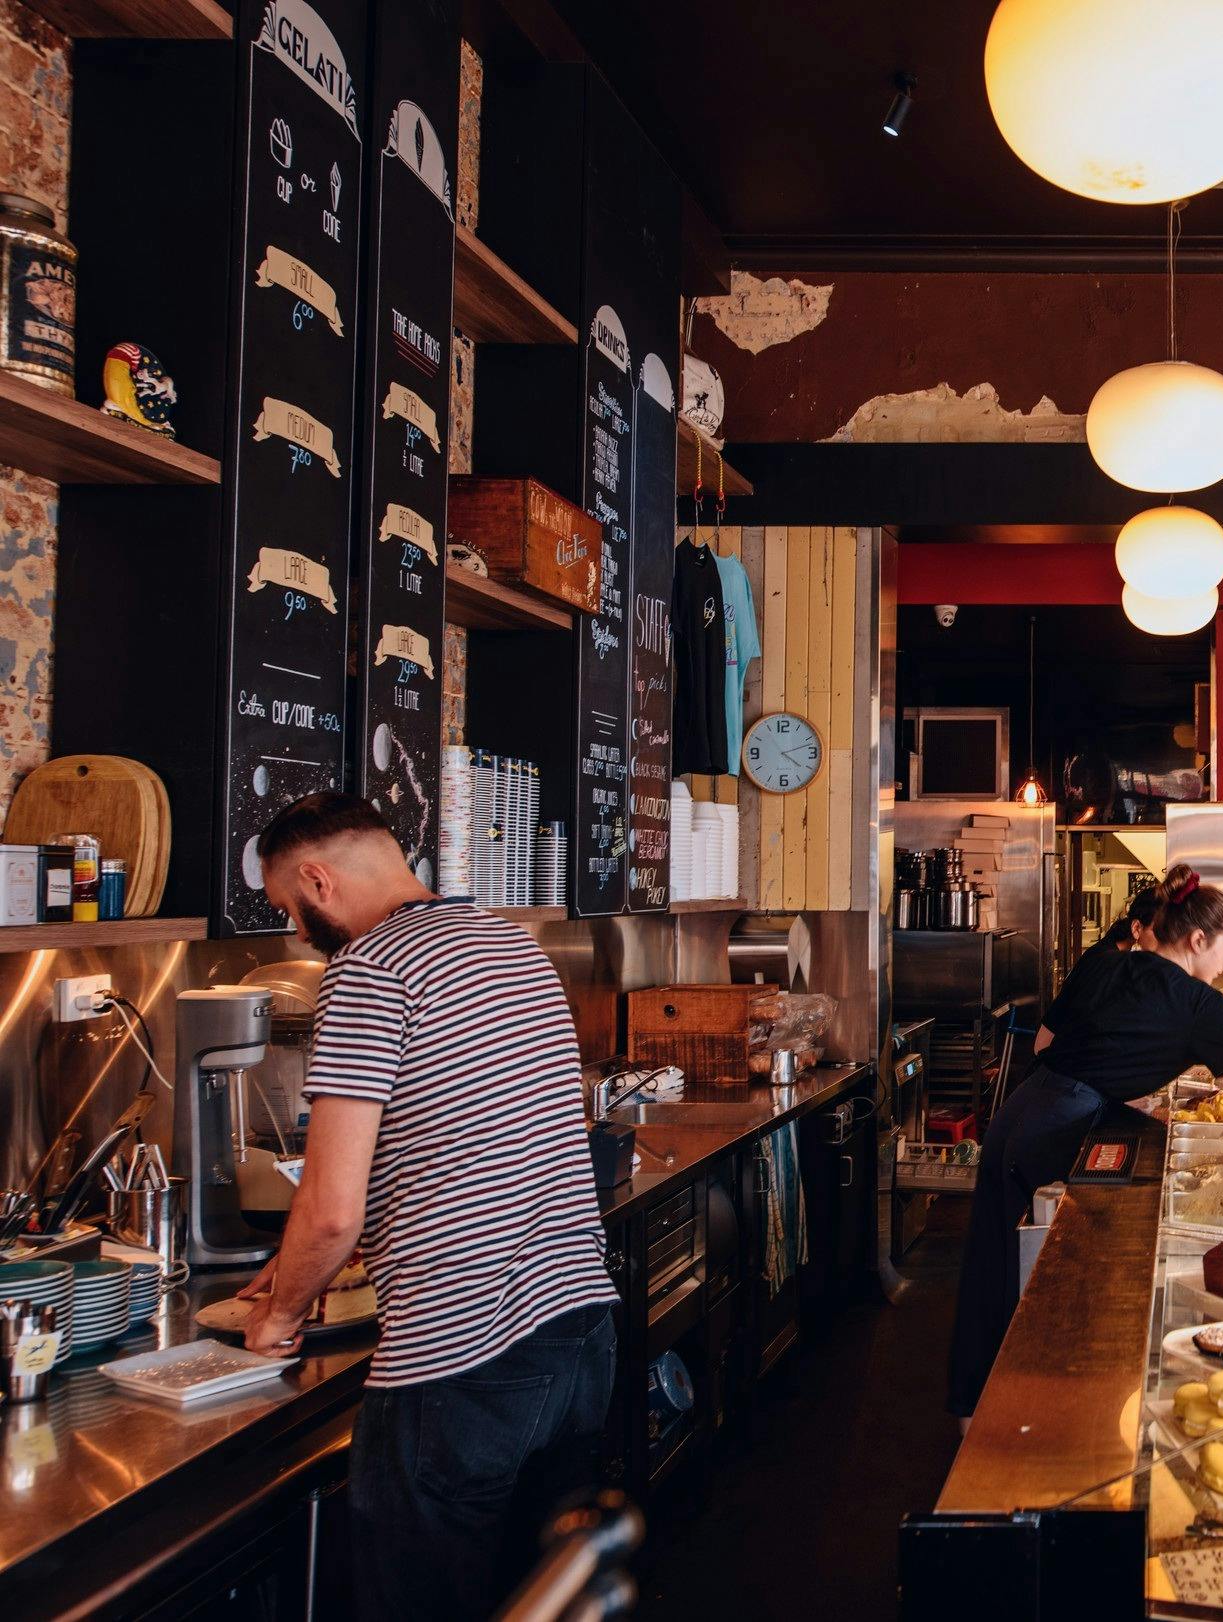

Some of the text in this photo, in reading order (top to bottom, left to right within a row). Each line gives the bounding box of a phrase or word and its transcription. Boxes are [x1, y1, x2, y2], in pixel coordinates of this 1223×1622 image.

[276, 173, 317, 204] CUP or
[322, 209, 341, 243] CONE
[288, 261, 316, 298] SMALL
[392, 308, 441, 365] TAKE HOME PACKS
[597, 320, 625, 363] DRINKS
[402, 392, 422, 424] SMALL
[286, 411, 316, 444] MEDIUM
[409, 453, 424, 478] LITRE
[283, 555, 308, 586] LARGE
[406, 572, 422, 595] LITRE
[636, 593, 666, 656] STAFF
[238, 690, 266, 718] Extra
[272, 700, 316, 730] CUP/CONE
[404, 688, 421, 711] LITRE
[777, 720, 791, 734] 12
[750, 747, 760, 760] 9
[808, 747, 818, 760] 3
[780, 775, 789, 788] 6
[634, 794, 671, 822] LAMINGTON
